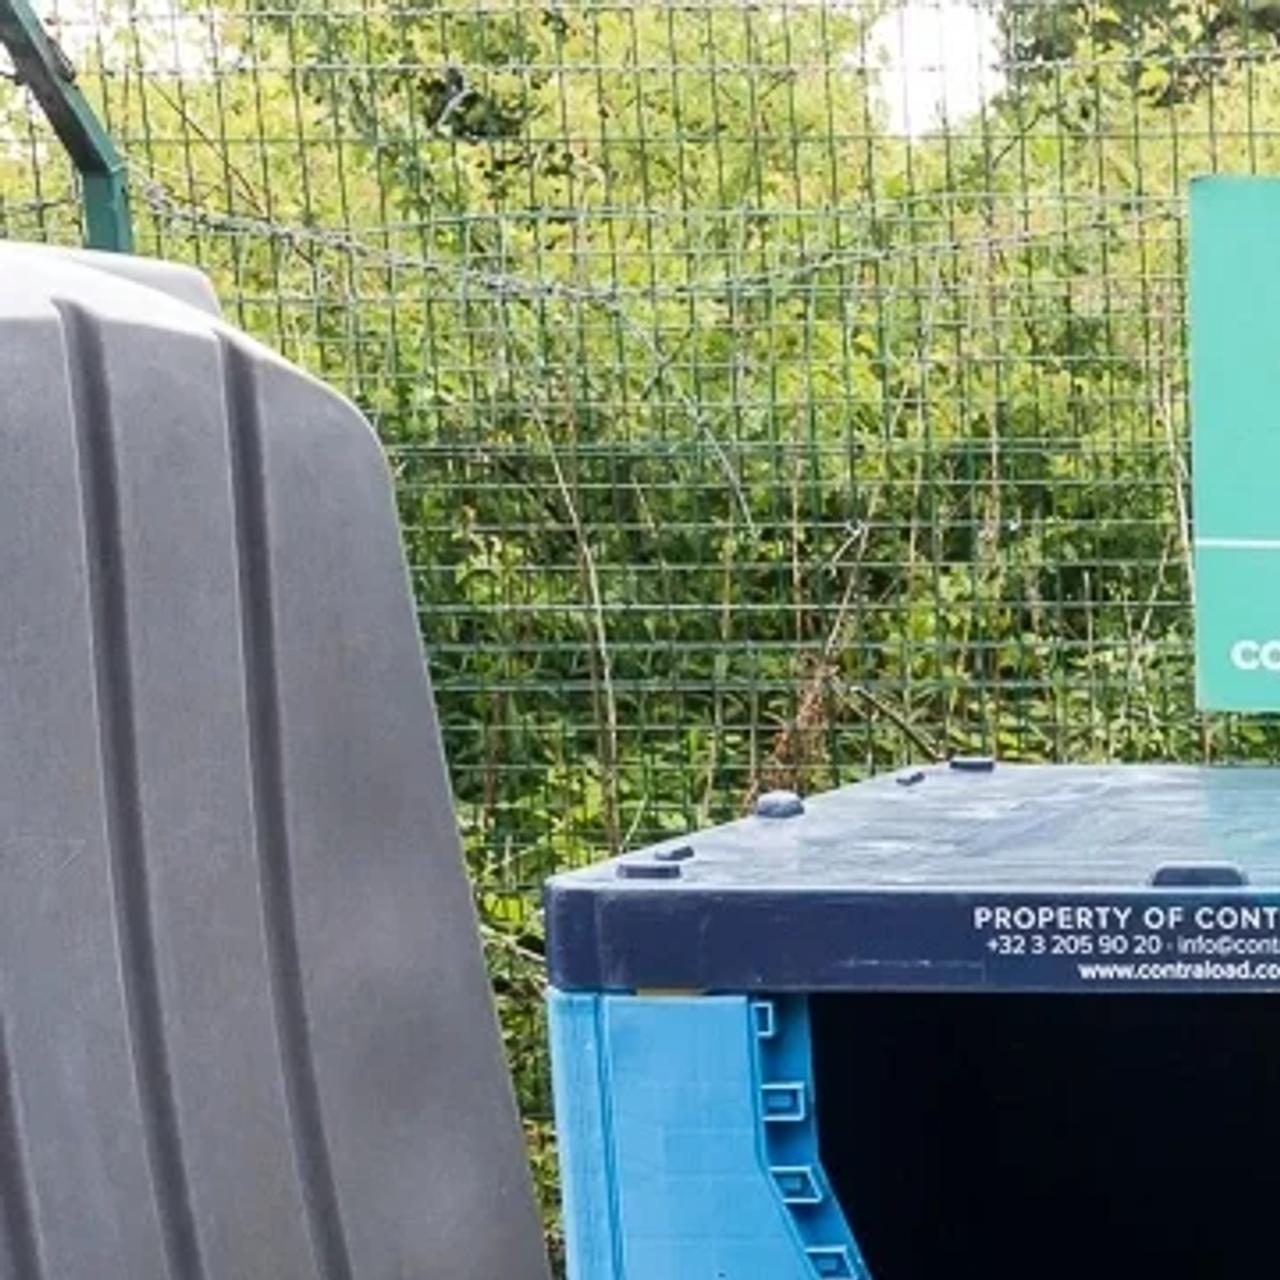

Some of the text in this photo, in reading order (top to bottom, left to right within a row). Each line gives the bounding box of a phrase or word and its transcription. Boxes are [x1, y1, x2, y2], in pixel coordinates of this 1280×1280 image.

[974, 906, 1132, 930] PROPERTY
[1143, 906, 1183, 930] OF
[986, 934, 1026, 955] +32
[1031, 934, 1047, 955] 3
[1051, 934, 1094, 955] 205
[1098, 934, 1129, 955] 90
[1133, 934, 1163, 955] 20
